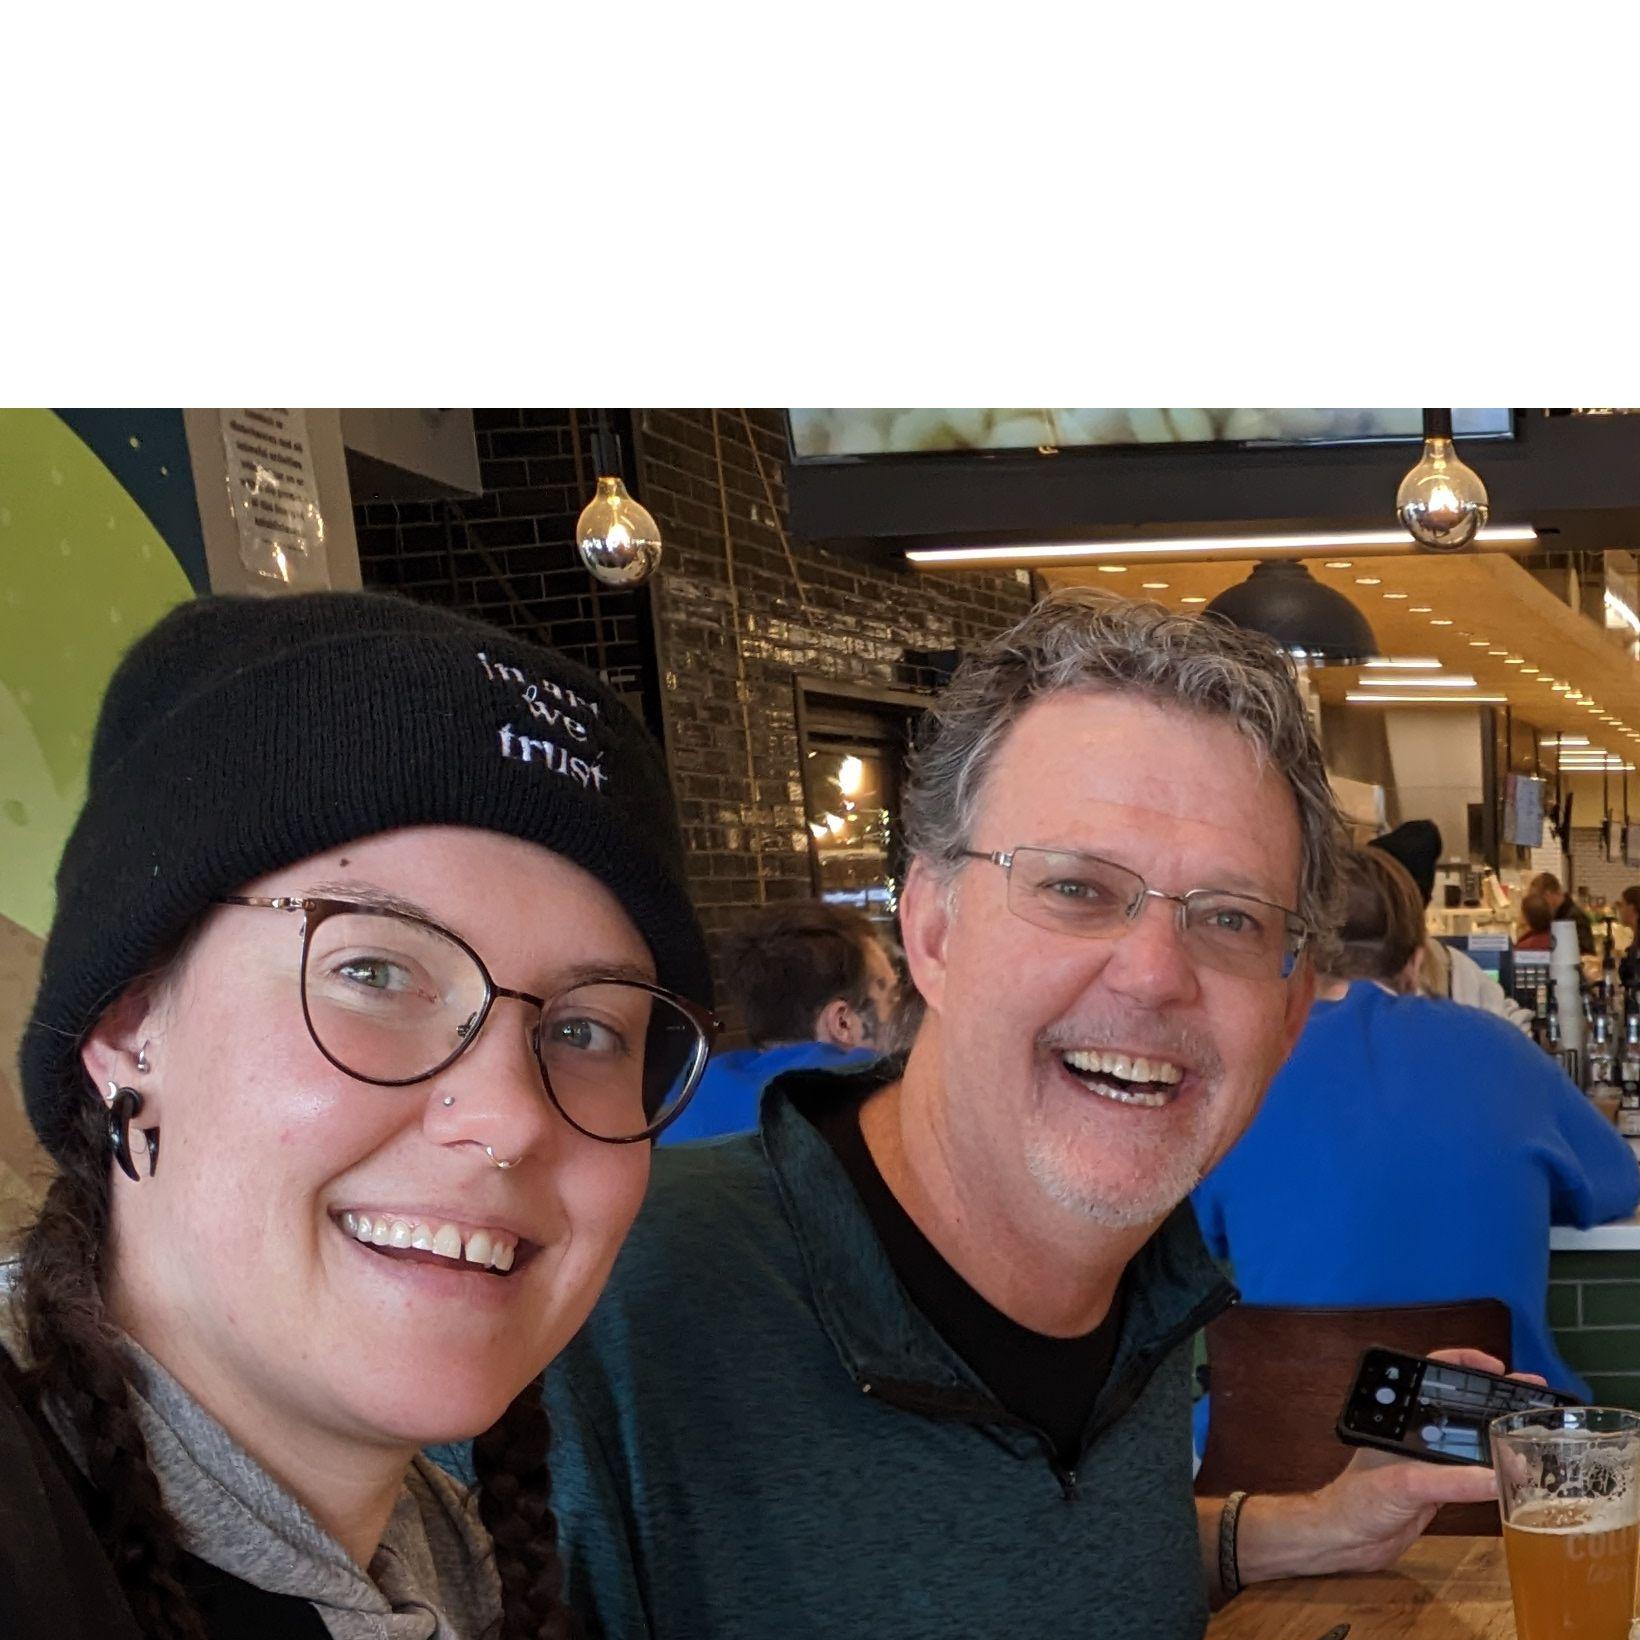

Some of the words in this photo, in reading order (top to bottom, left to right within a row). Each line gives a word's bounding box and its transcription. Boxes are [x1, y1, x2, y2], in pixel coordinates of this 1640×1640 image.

[477, 652, 526, 684] in
[521, 684, 588, 742] we
[498, 723, 609, 791] trust
